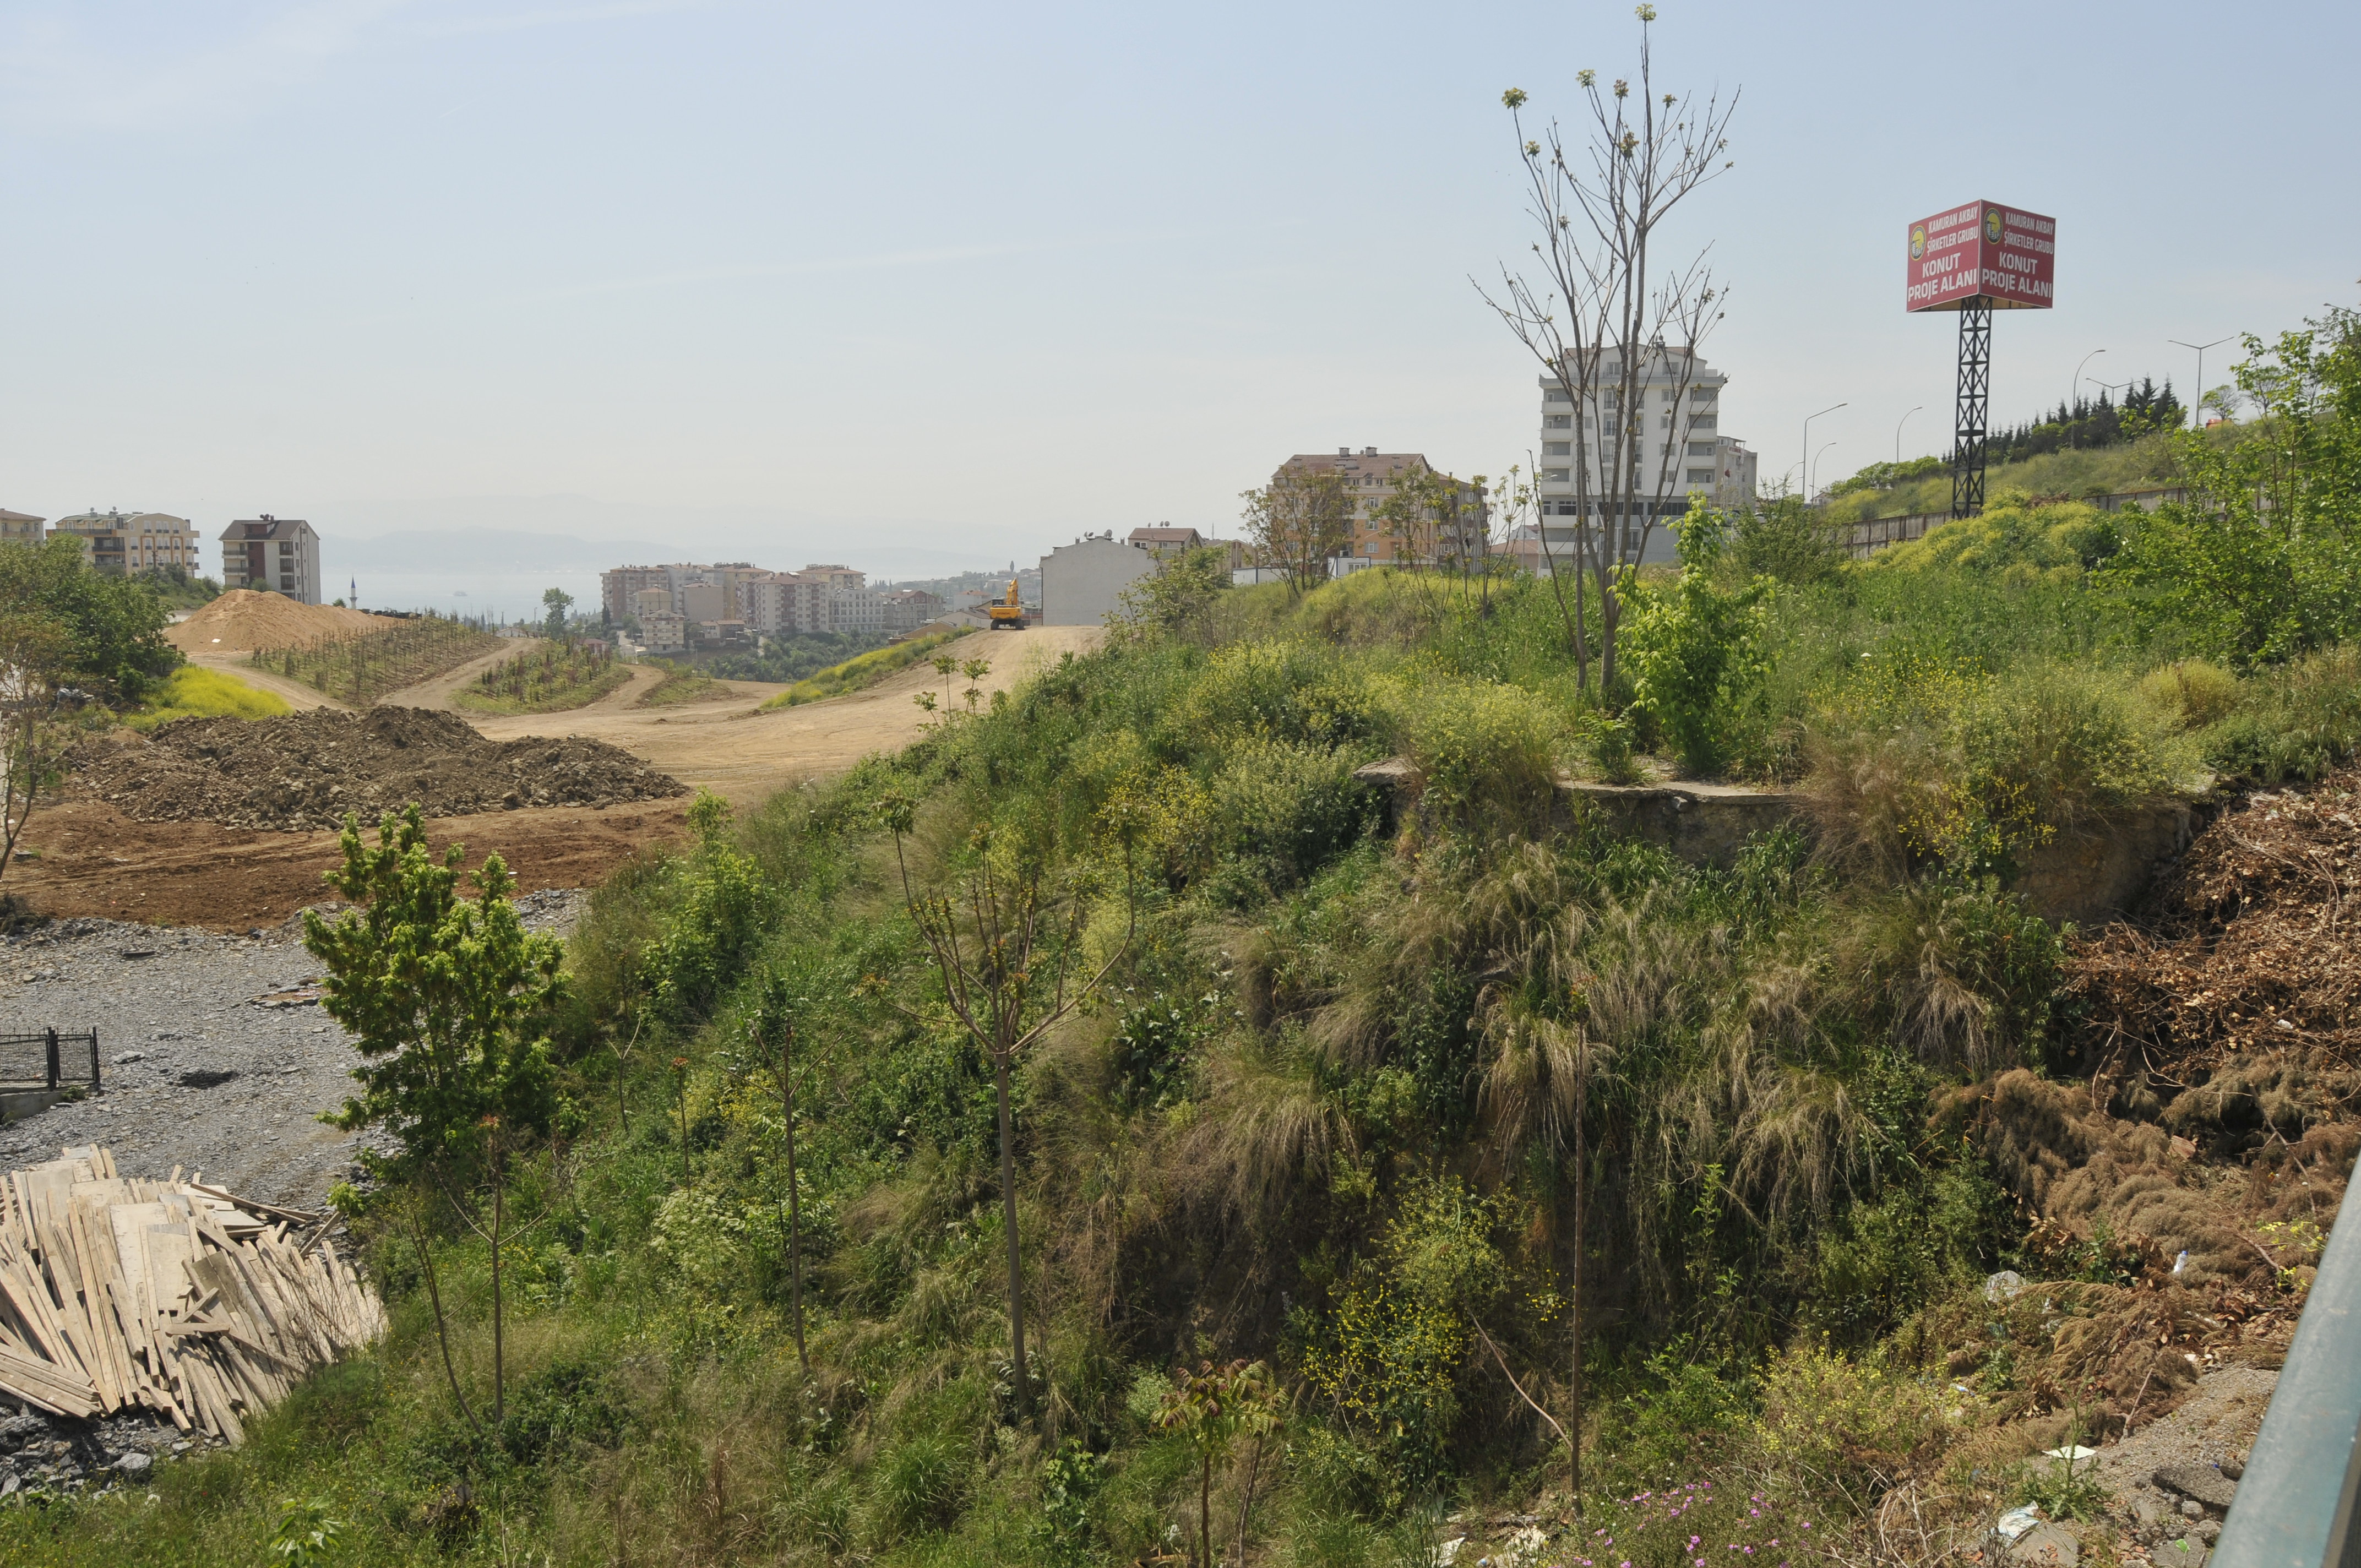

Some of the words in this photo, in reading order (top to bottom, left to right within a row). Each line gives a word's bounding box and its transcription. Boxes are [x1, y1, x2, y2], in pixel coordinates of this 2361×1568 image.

[1928, 213, 1958, 233] KAMURAN
[1959, 206, 1978, 224] AKBAY
[2005, 212, 2034, 230] KAMURAN
[2036, 220, 2053, 235] AKBAY
[1927, 232, 1956, 256] ŞİRKETLER
[1957, 226, 1978, 244] GRUBU
[2004, 228, 2034, 250] ŞİRKETLER
[2035, 239, 2053, 254] GRUBU
[1922, 253, 1961, 277] KONUT
[1999, 252, 2037, 274] KONUT
[1908, 279, 1938, 302] PROJE
[1940, 269, 1977, 293] ALANI
[1982, 269, 2015, 292] PROJE
[2018, 277, 2052, 298] ALANI
